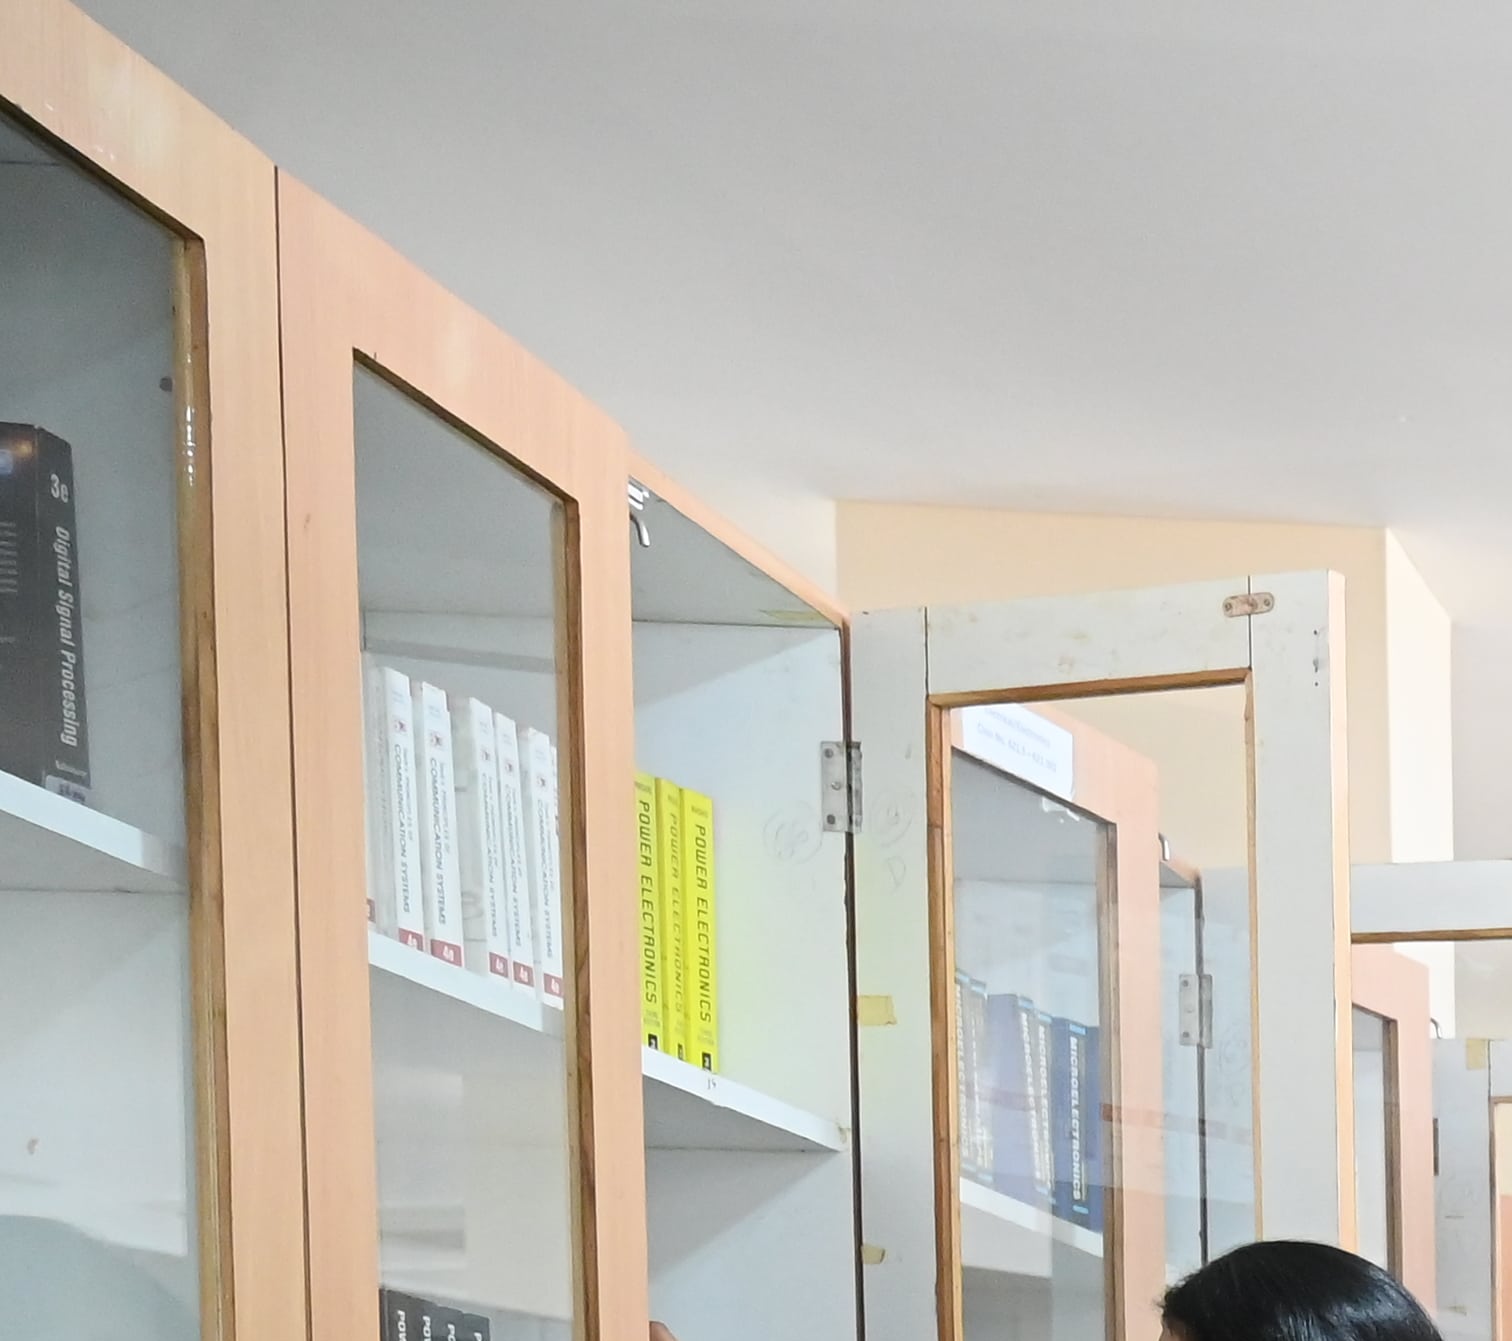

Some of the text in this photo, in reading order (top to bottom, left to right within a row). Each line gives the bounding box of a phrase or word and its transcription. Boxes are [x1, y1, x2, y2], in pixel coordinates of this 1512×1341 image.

[50, 472, 69, 504] 3e
[53, 526, 78, 748] Digital Signal Processing
[394, 743, 408, 859] COMMUNICATION
[429, 756, 447, 926] COMMUNICATION SYSTEMS
[399, 861, 410, 914] SYSTEMS
[639, 799, 657, 1004] POWER ELECTRONICS
[670, 812, 683, 1014] POWER ELECTRONICS
[695, 823, 712, 1024] POWER ELECTRONICS
[1068, 1034, 1082, 1202] MICROELECTRONICS
